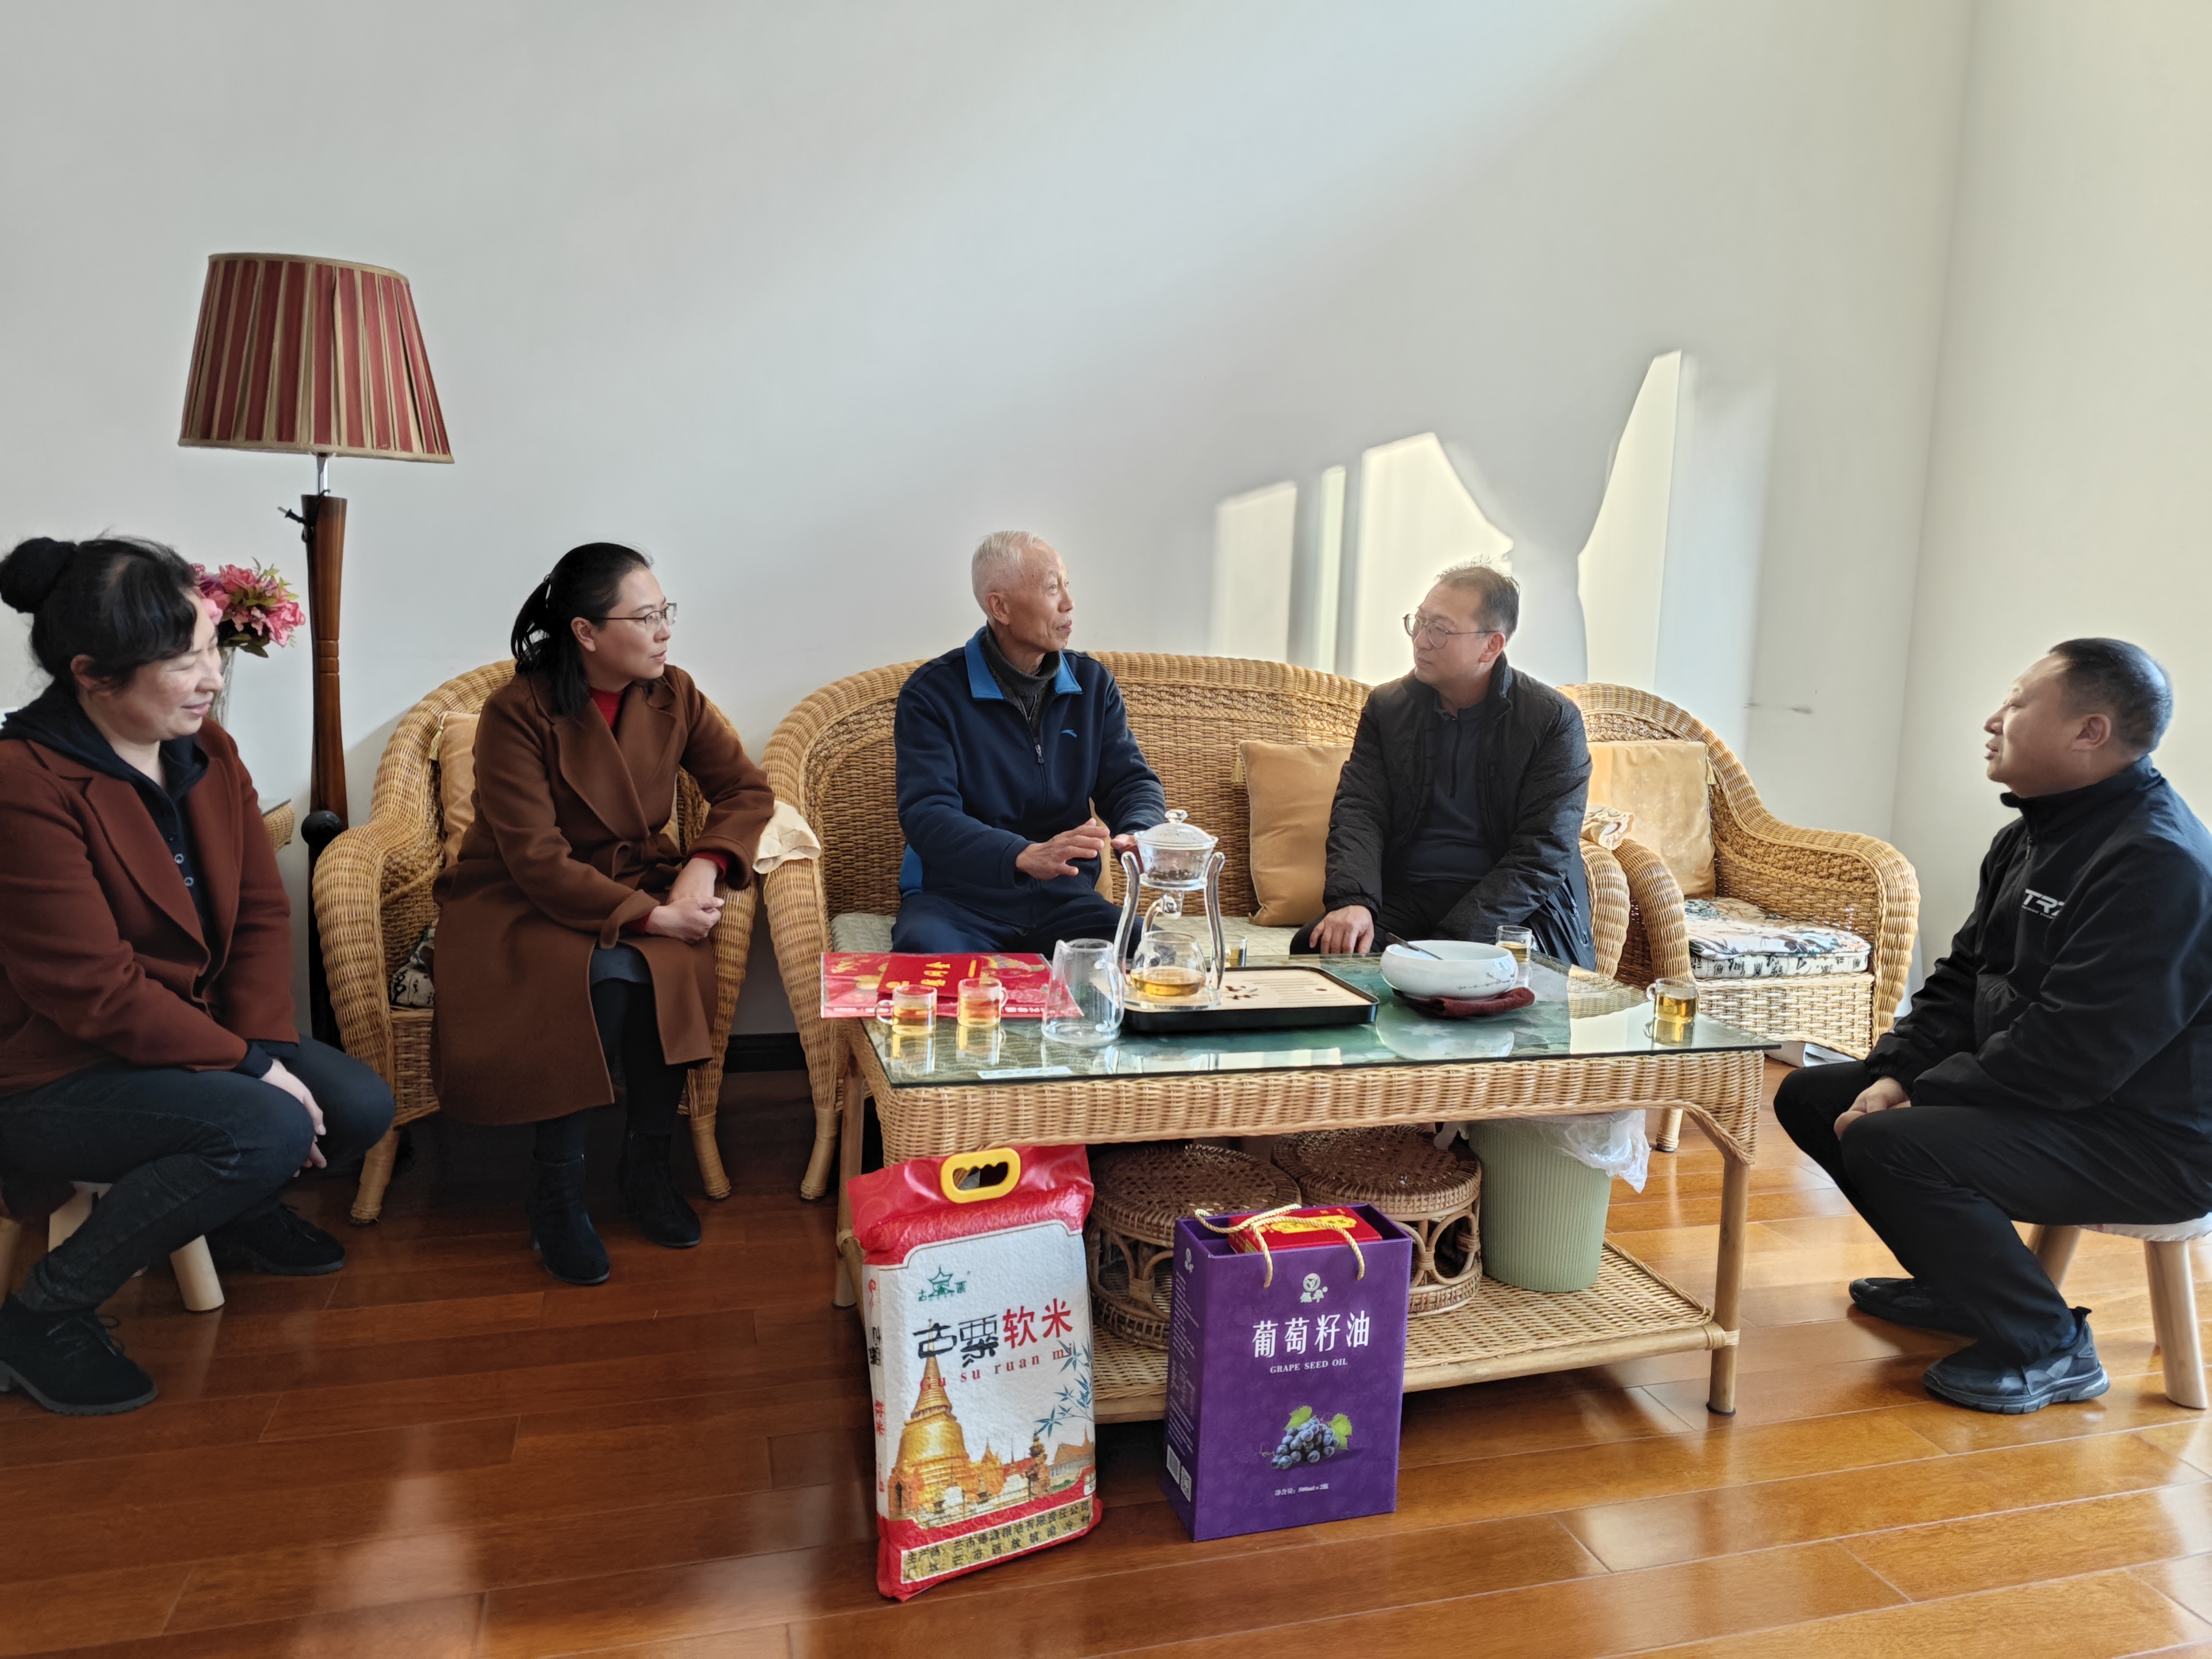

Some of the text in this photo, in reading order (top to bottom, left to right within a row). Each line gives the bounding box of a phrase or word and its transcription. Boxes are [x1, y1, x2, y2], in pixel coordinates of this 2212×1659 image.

[1252, 1310, 1370, 1358] 葡萄籽油
[920, 1343, 1073, 1391] Gu su ruan mi
[1270, 1357, 1348, 1374] GRAPE SEED OIL
